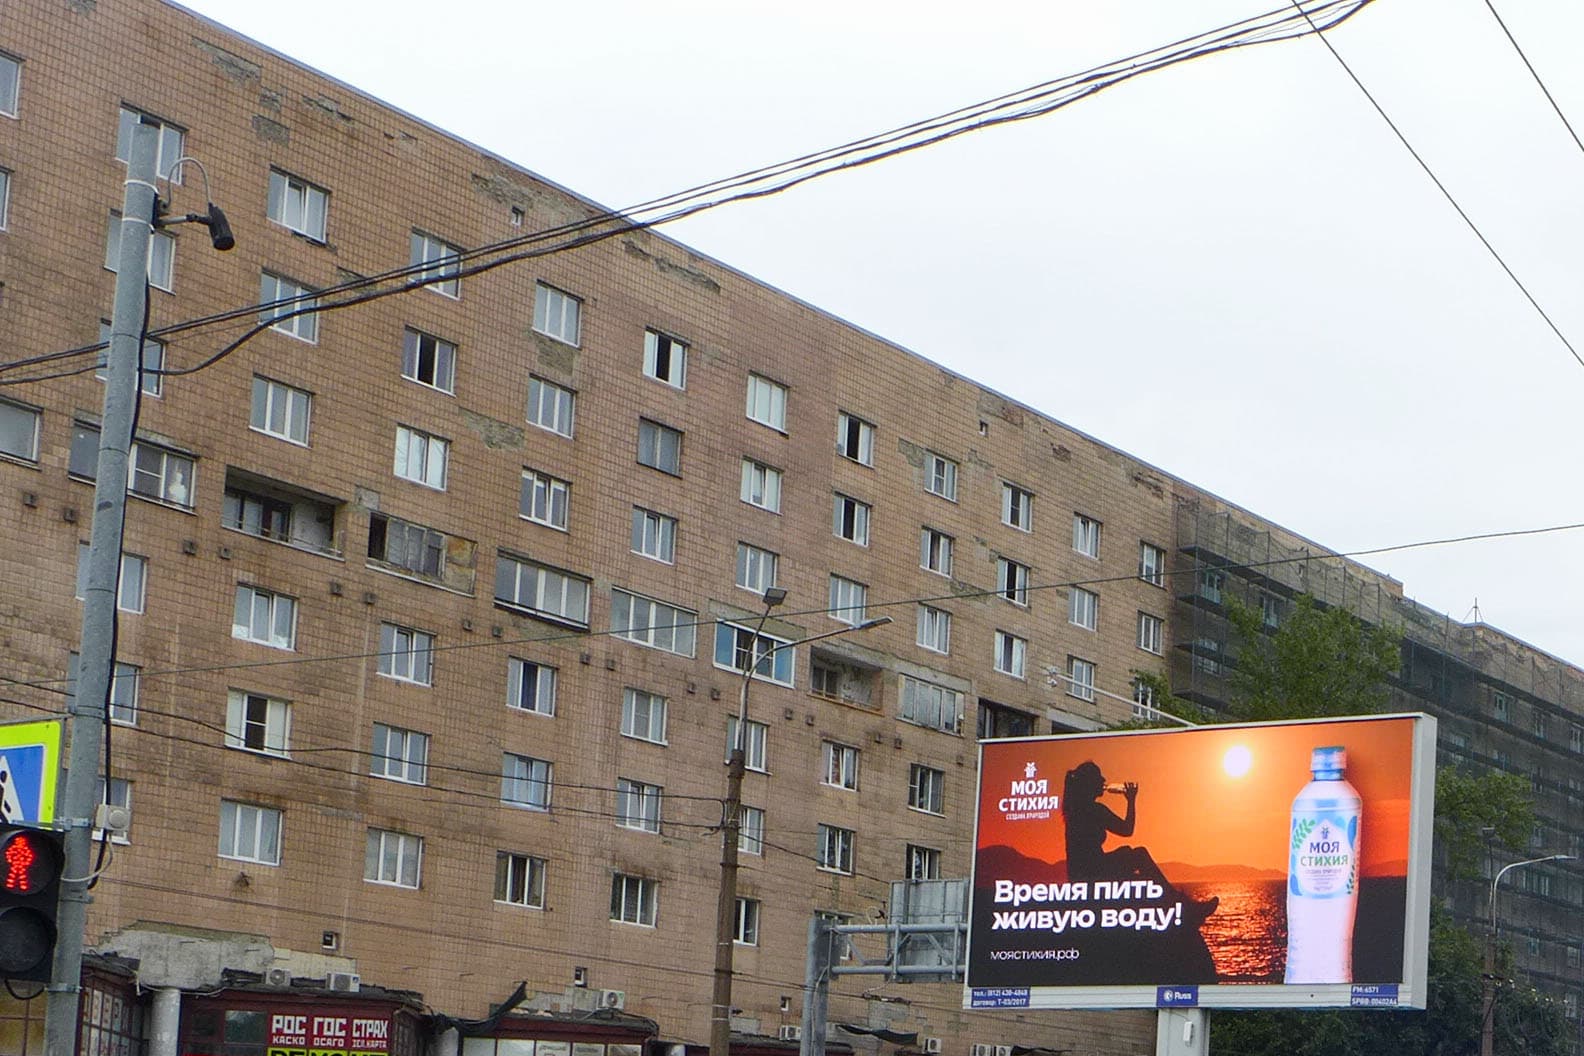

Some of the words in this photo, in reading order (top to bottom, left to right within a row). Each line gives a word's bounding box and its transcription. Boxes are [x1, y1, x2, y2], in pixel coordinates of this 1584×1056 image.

[1011, 779, 1048, 796] МОЯ
[999, 796, 1059, 812] СТИХИЯ
[1309, 841, 1340, 853] МОЯ
[1300, 854, 1348, 867] СТИХИЯ
[994, 880, 1088, 906] Время
[1094, 880, 1163, 900] пить
[992, 909, 1096, 933] живую
[1101, 903, 1182, 931] воду!
[990, 948, 1080, 961] моястихия.рф
[272, 1015, 306, 1035] РОС
[313, 1017, 348, 1037] ГОС
[352, 1019, 389, 1038] СТРАХ
[272, 1036, 306, 1045] КАСКО
[313, 1038, 345, 1047] ОСАГО
